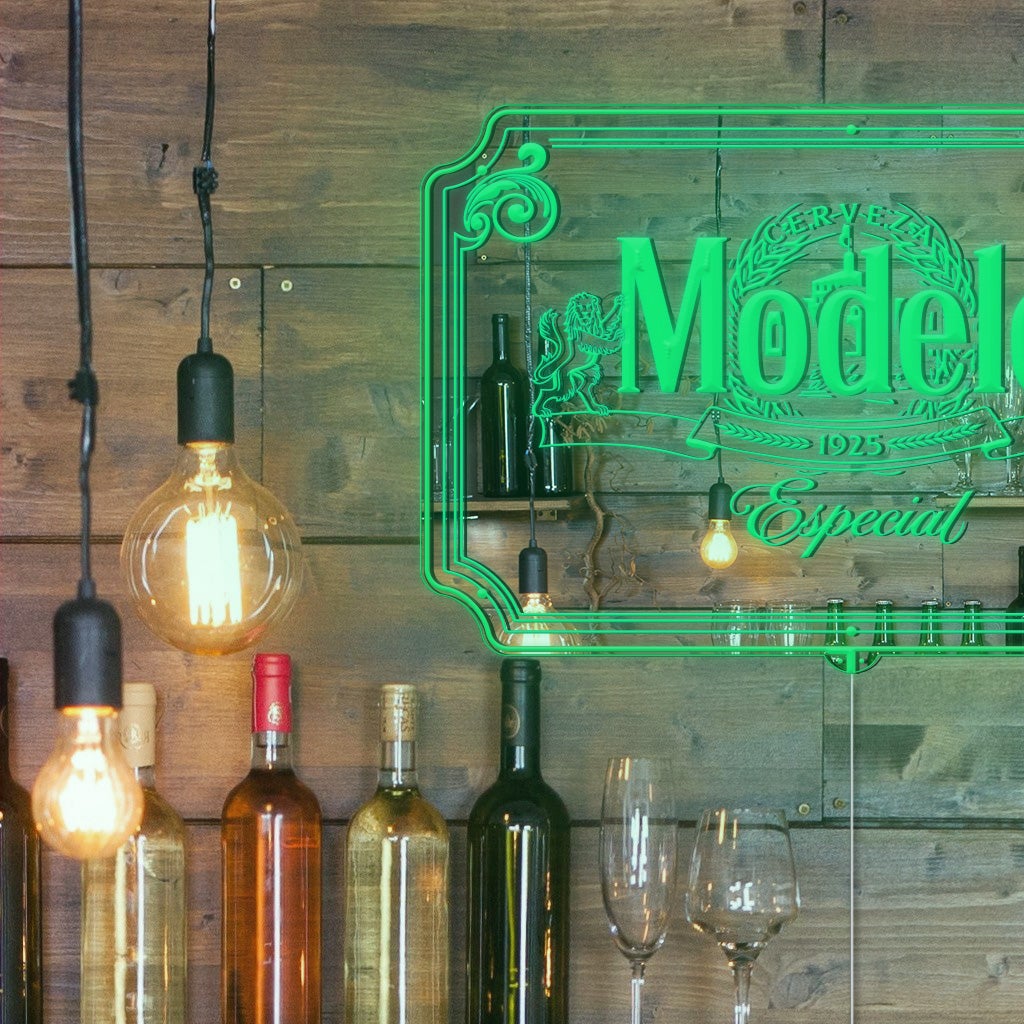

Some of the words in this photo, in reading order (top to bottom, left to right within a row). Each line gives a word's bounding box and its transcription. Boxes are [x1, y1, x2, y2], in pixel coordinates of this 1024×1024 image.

[764, 203, 935, 246] CERVEZA
[819, 433, 886, 457] 1925
[729, 477, 976, 559] Especial
